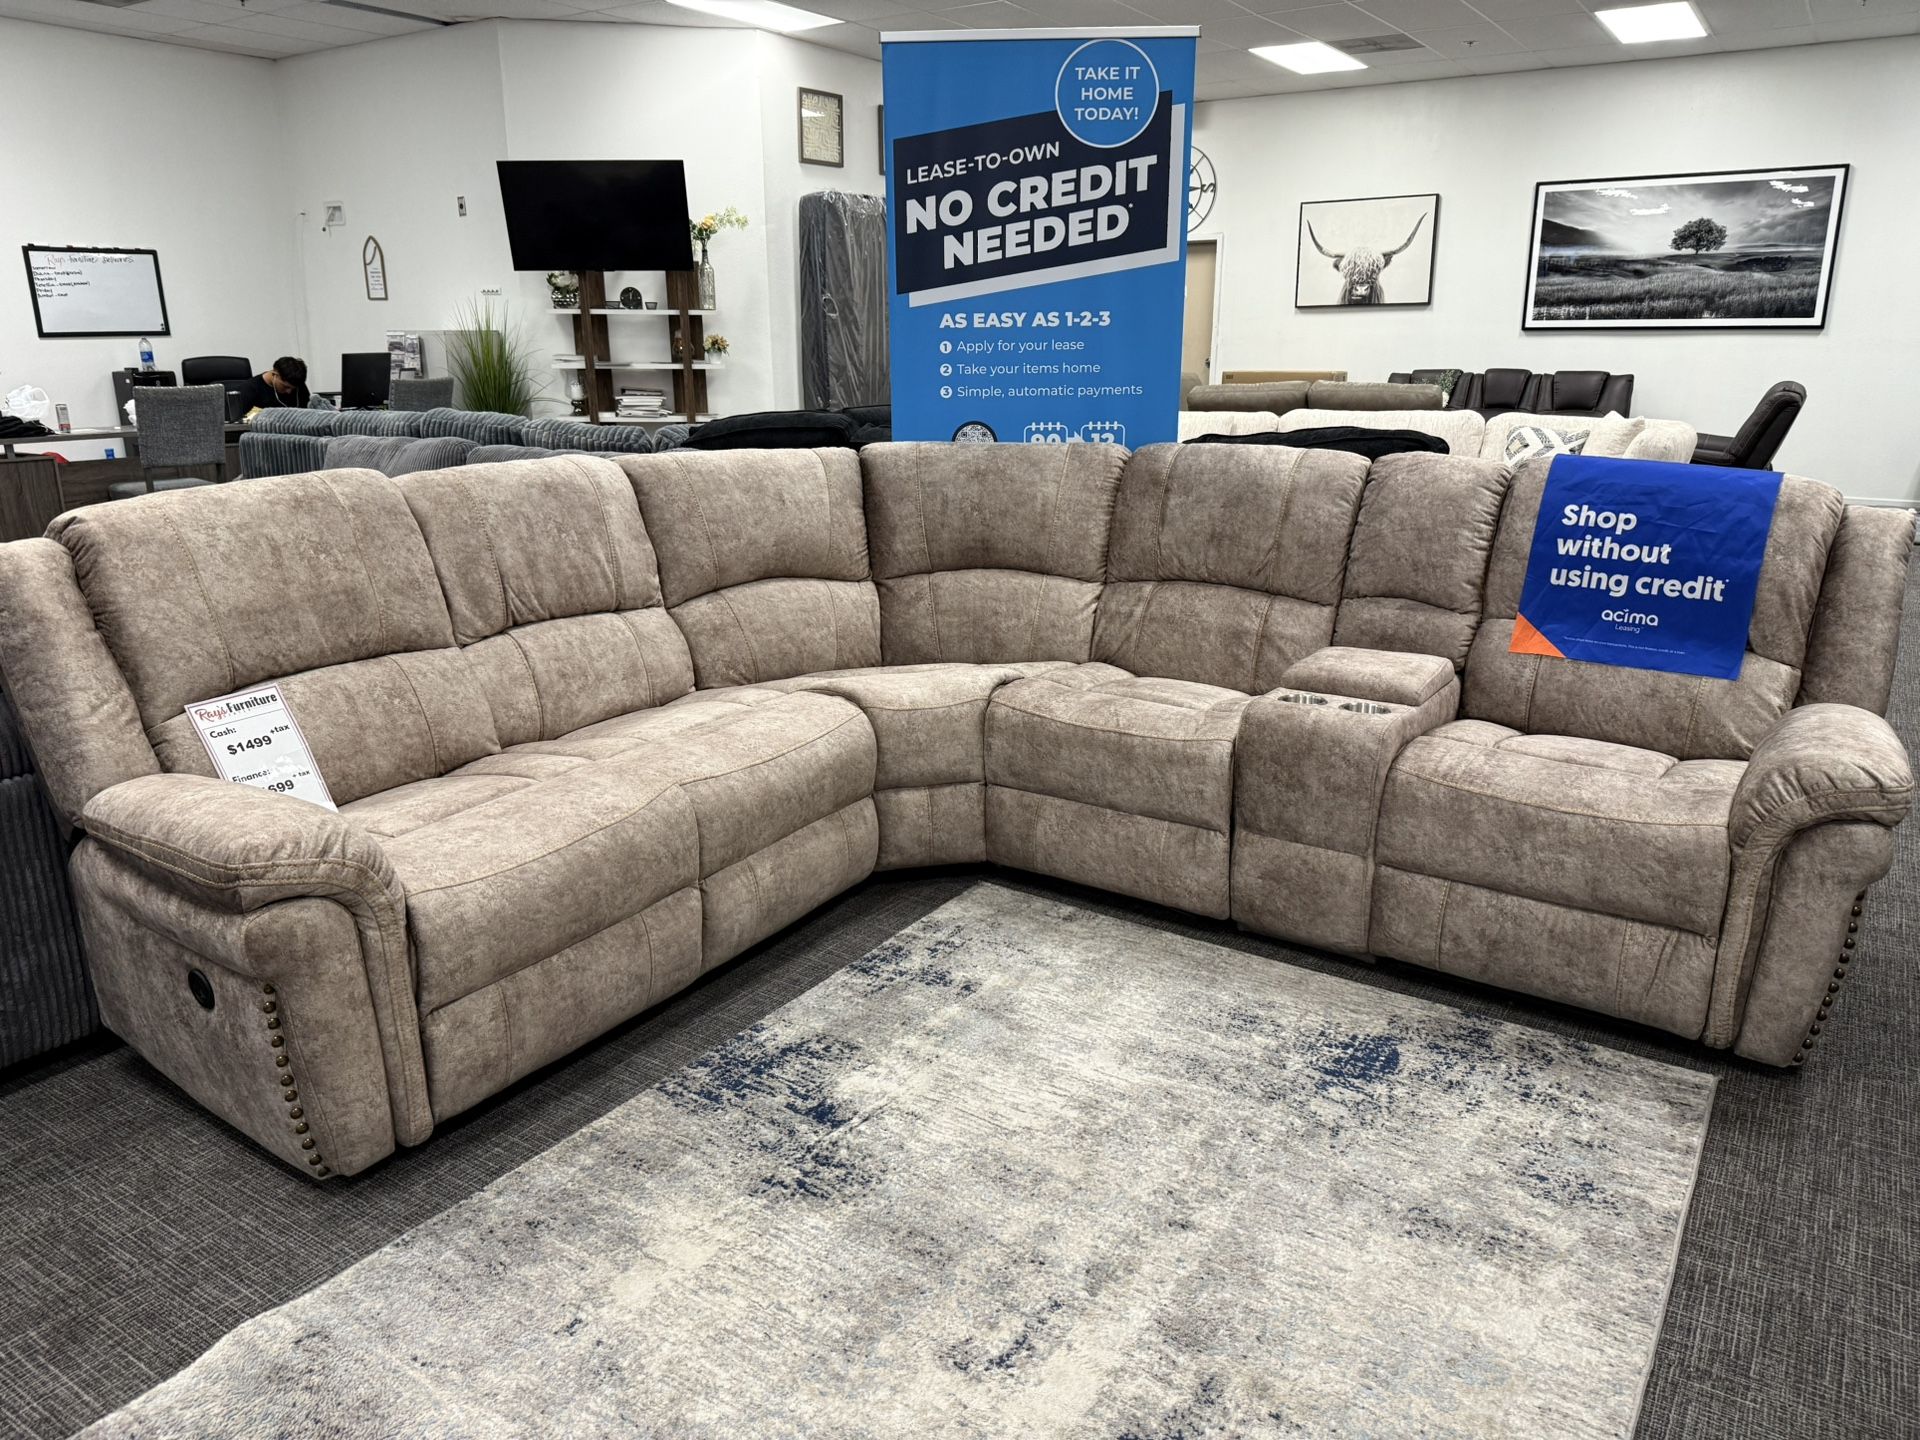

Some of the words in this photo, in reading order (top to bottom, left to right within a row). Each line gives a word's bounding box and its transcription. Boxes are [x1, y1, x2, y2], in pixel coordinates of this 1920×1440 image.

[1074, 66, 1120, 81] TAKE
[1125, 66, 1141, 80] IT
[1081, 86, 1134, 101] HOME
[1074, 106, 1139, 121] TODAY!
[906, 141, 1061, 185] LEASE-TO-OWN
[905, 189, 974, 235] NO
[986, 154, 1159, 218] CREDIT
[939, 312, 968, 329] AS
[973, 312, 1027, 328] EASY
[1031, 311, 1060, 328] AS
[1064, 310, 1111, 327] 1-2-3
[956, 339, 995, 354] Apply
[997, 339, 1016, 351] for
[1018, 342, 1048, 354] your
[1051, 339, 1085, 351] lease
[956, 363, 987, 375] Take
[989, 365, 1020, 377] your
[1023, 362, 1060, 374] items
[1062, 362, 1101, 374] home
[957, 385, 1005, 400] Simple,
[1007, 384, 1075, 397] automatic
[1077, 384, 1143, 398] payments
[1561, 504, 1638, 535] Shop
[1556, 534, 1672, 565] without
[1549, 565, 1630, 597] using
[1600, 608, 1660, 627] acima
[1614, 623, 1642, 634] Leasing
[226, 694, 278, 713] Furniture
[209, 727, 237, 738] Cash:
[227, 735, 272, 755] $1499
